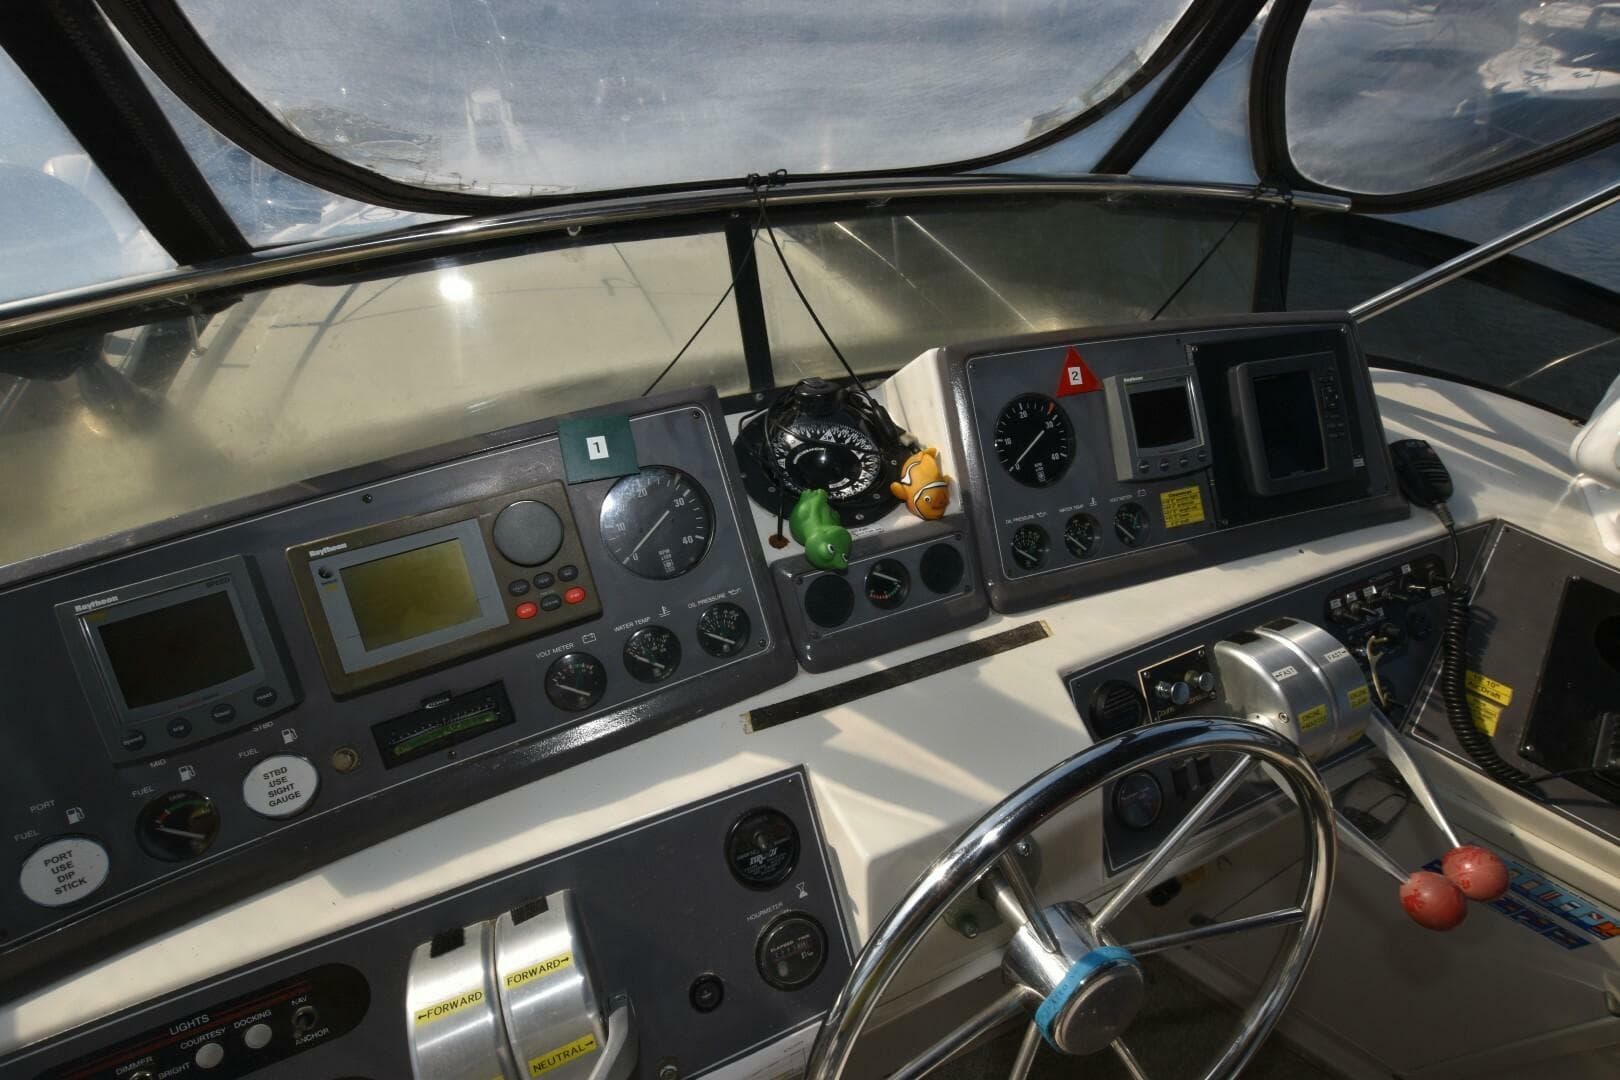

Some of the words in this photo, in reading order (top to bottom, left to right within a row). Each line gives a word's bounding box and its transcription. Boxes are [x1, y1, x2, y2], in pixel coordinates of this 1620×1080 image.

[1071, 371, 1080, 381] 2
[592, 442, 601, 453] 1
[638, 487, 648, 498] 20
[673, 497, 685, 508] 30
[682, 535, 694, 545] 40
[308, 543, 348, 559] Raytheon
[632, 552, 639, 561] 0
[74, 595, 119, 613] Raytheon
[697, 591, 726, 606] PRESSURE
[613, 621, 634, 633] WATER
[635, 616, 652, 626] TEMP
[536, 647, 552, 659] VOLT
[552, 641, 576, 655] METER
[1328, 651, 1342, 661] FAST
[1280, 667, 1294, 678] FAST
[252, 721, 275, 733] STBD
[238, 747, 259, 759] FUEL
[149, 758, 167, 769] MID
[263, 766, 288, 780] STBD
[269, 776, 288, 788] USE
[132, 786, 155, 798] FUEL
[268, 783, 295, 798] SIGHT
[269, 790, 301, 807] GAUGE
[29, 799, 56, 814] PORT
[13, 828, 39, 842] FUEL
[43, 849, 73, 868] PORT
[50, 860, 75, 875] USE
[56, 871, 76, 883] DIP
[53, 876, 88, 895] STICK
[746, 901, 784, 922] HOURMETER
[506, 958, 562, 987] FORWARD
[291, 995, 308, 1007] NAV
[426, 990, 483, 1019] FORWARD
[169, 1013, 210, 1036] LIGHTS
[233, 1008, 273, 1030] DOCKING
[180, 1026, 226, 1051] COURTESY
[295, 1027, 330, 1046] ANCHOR
[115, 1055, 153, 1077] DIMMER
[532, 1043, 587, 1074] NEUTRAL
[158, 1061, 192, 1080] BRIGHT
